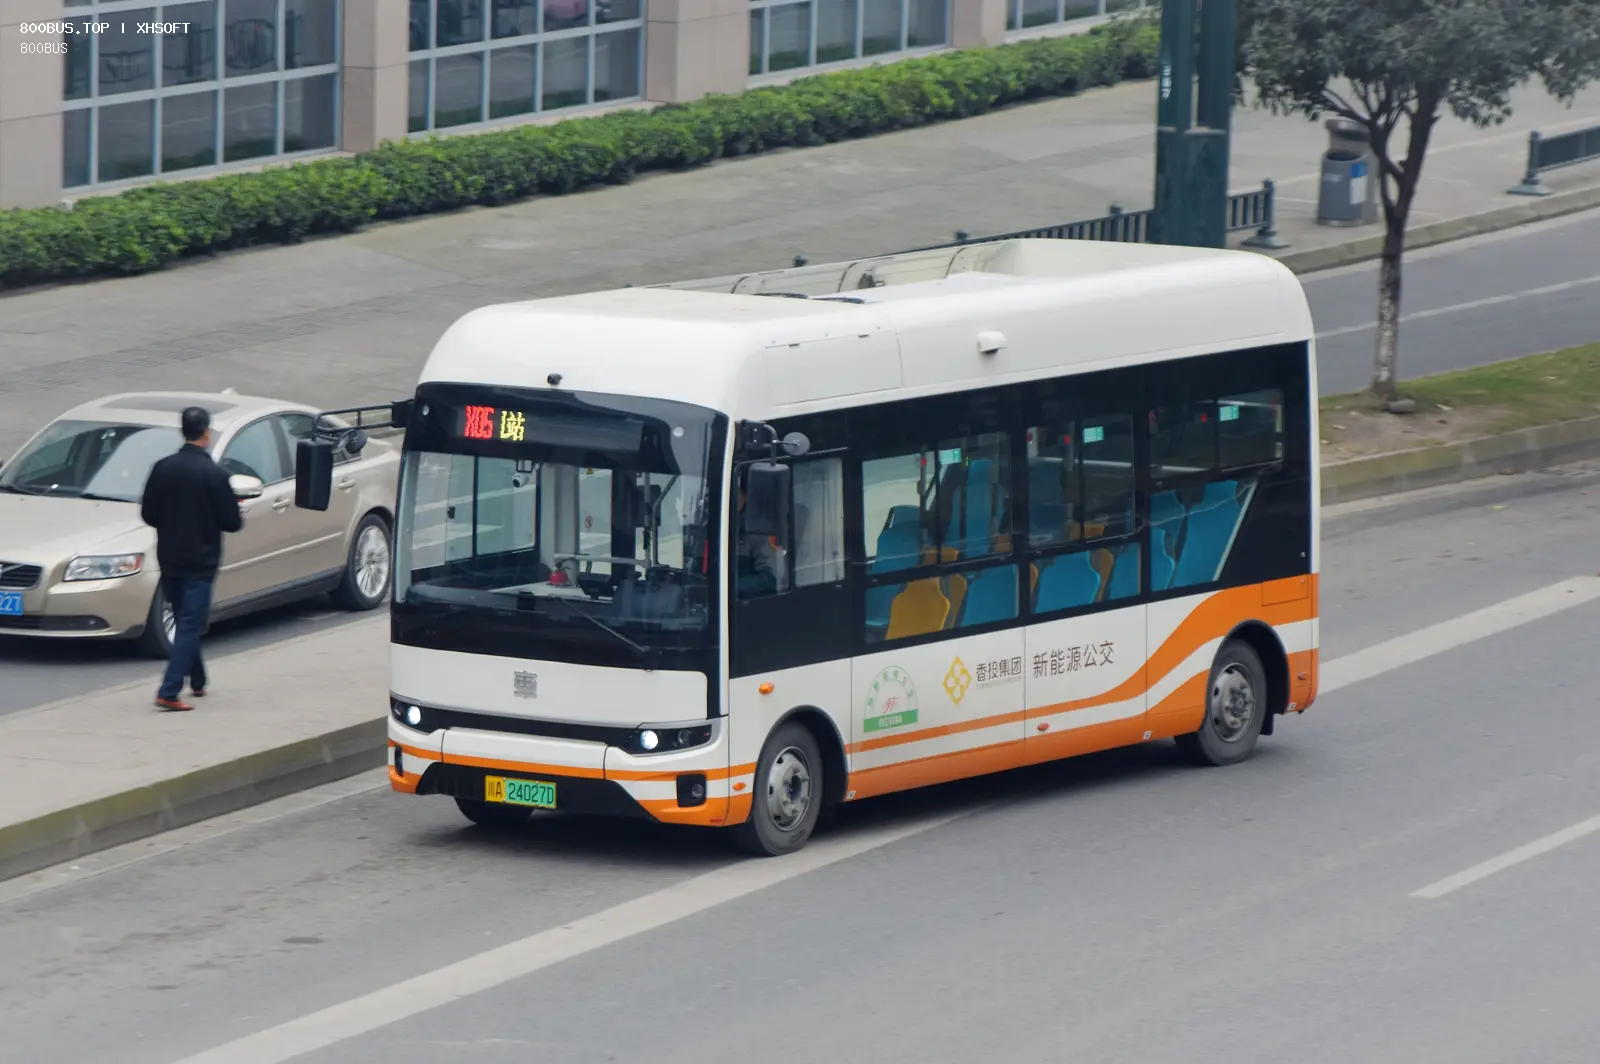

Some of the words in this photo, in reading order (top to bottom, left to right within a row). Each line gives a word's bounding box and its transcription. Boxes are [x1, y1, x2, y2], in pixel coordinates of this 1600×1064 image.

[976, 656, 1022, 682] 香投集团
[1033, 640, 1115, 679] 新能源公交
